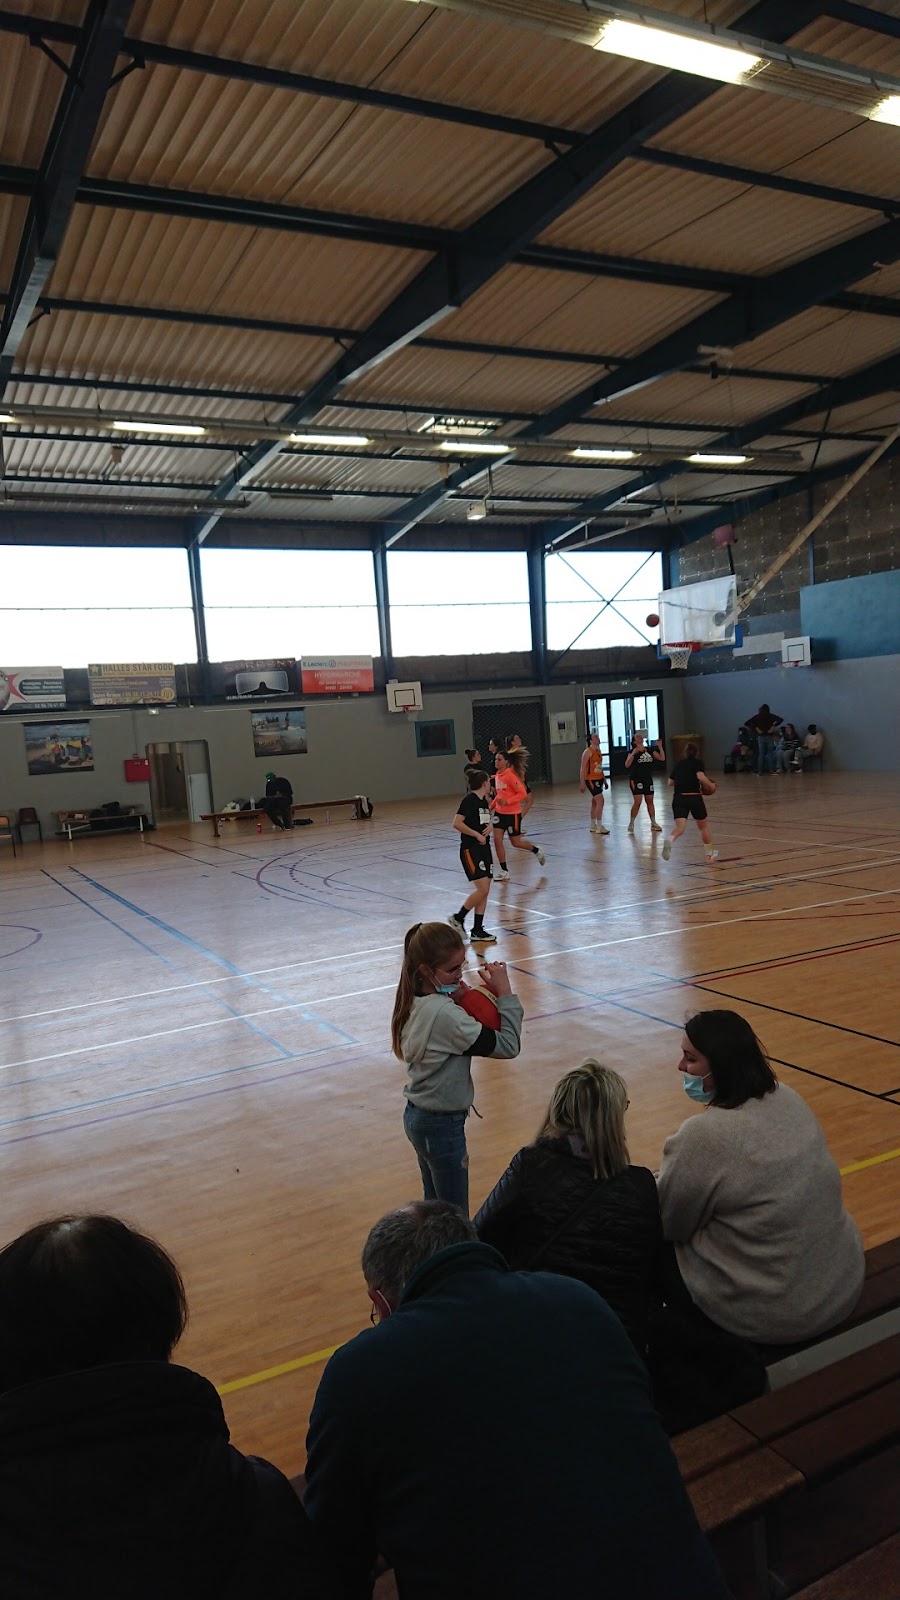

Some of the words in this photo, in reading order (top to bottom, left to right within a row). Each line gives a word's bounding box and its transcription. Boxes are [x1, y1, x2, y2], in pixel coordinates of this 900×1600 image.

[103, 664, 131, 672] HALLES
[132, 663, 152, 672] STAR
[154, 663, 173, 671] FOOD
